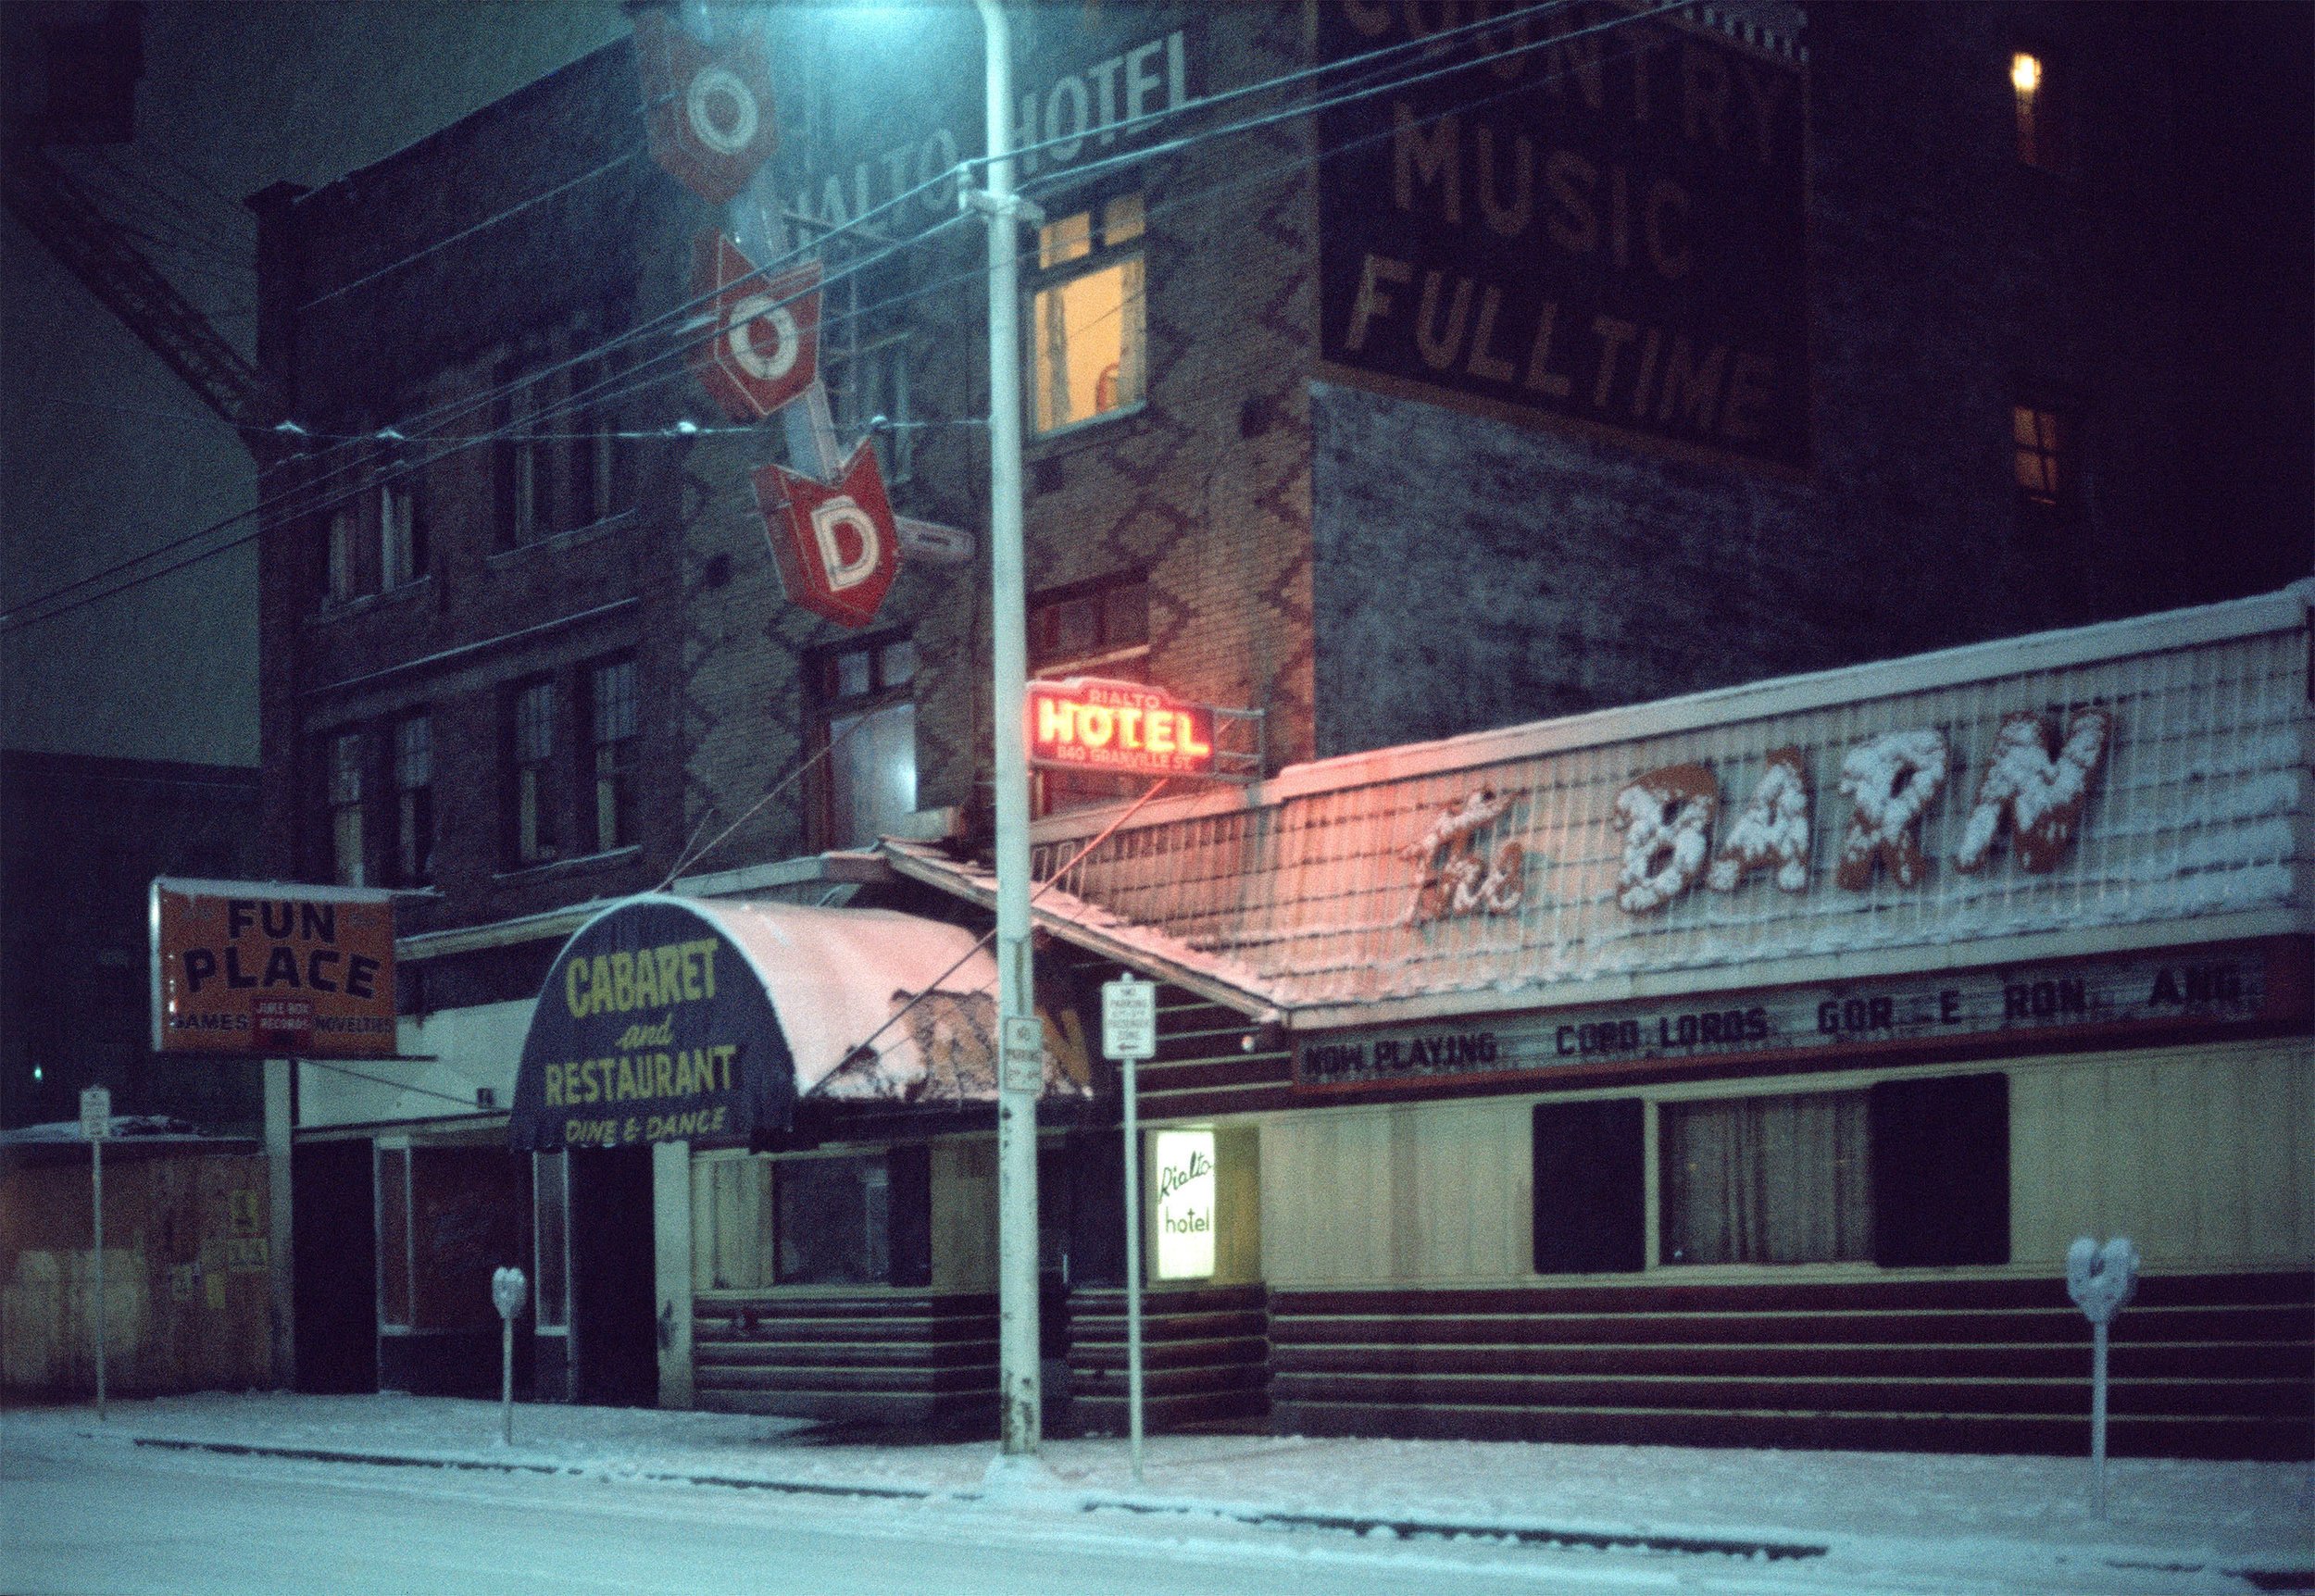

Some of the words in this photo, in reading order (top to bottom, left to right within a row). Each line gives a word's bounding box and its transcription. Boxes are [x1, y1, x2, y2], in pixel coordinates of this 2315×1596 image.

[1394, 101, 1690, 277] MUSIC
[1038, 698, 1209, 754] HOTEL
[1090, 689, 1160, 710] RIALTO
[1091, 746, 1170, 768] GRANVILLE
[1613, 709, 2112, 915] BARN
[229, 899, 334, 943] FUN
[183, 946, 380, 1000] PLACE
[565, 938, 719, 1019] CABARET
[614, 1012, 674, 1052] and
[1307, 1044, 1363, 1075] NOW
[1374, 1032, 1497, 1072] PLAYING
[1659, 1006, 1768, 1048] LORDS
[544, 1043, 737, 1107] RESTAURANT
[565, 1118, 619, 1143] DINE
[623, 1116, 641, 1142] &
[647, 1106, 727, 1140] DANCE
[1158, 1151, 1215, 1204] Rialto
[1166, 1206, 1209, 1233] hotel
